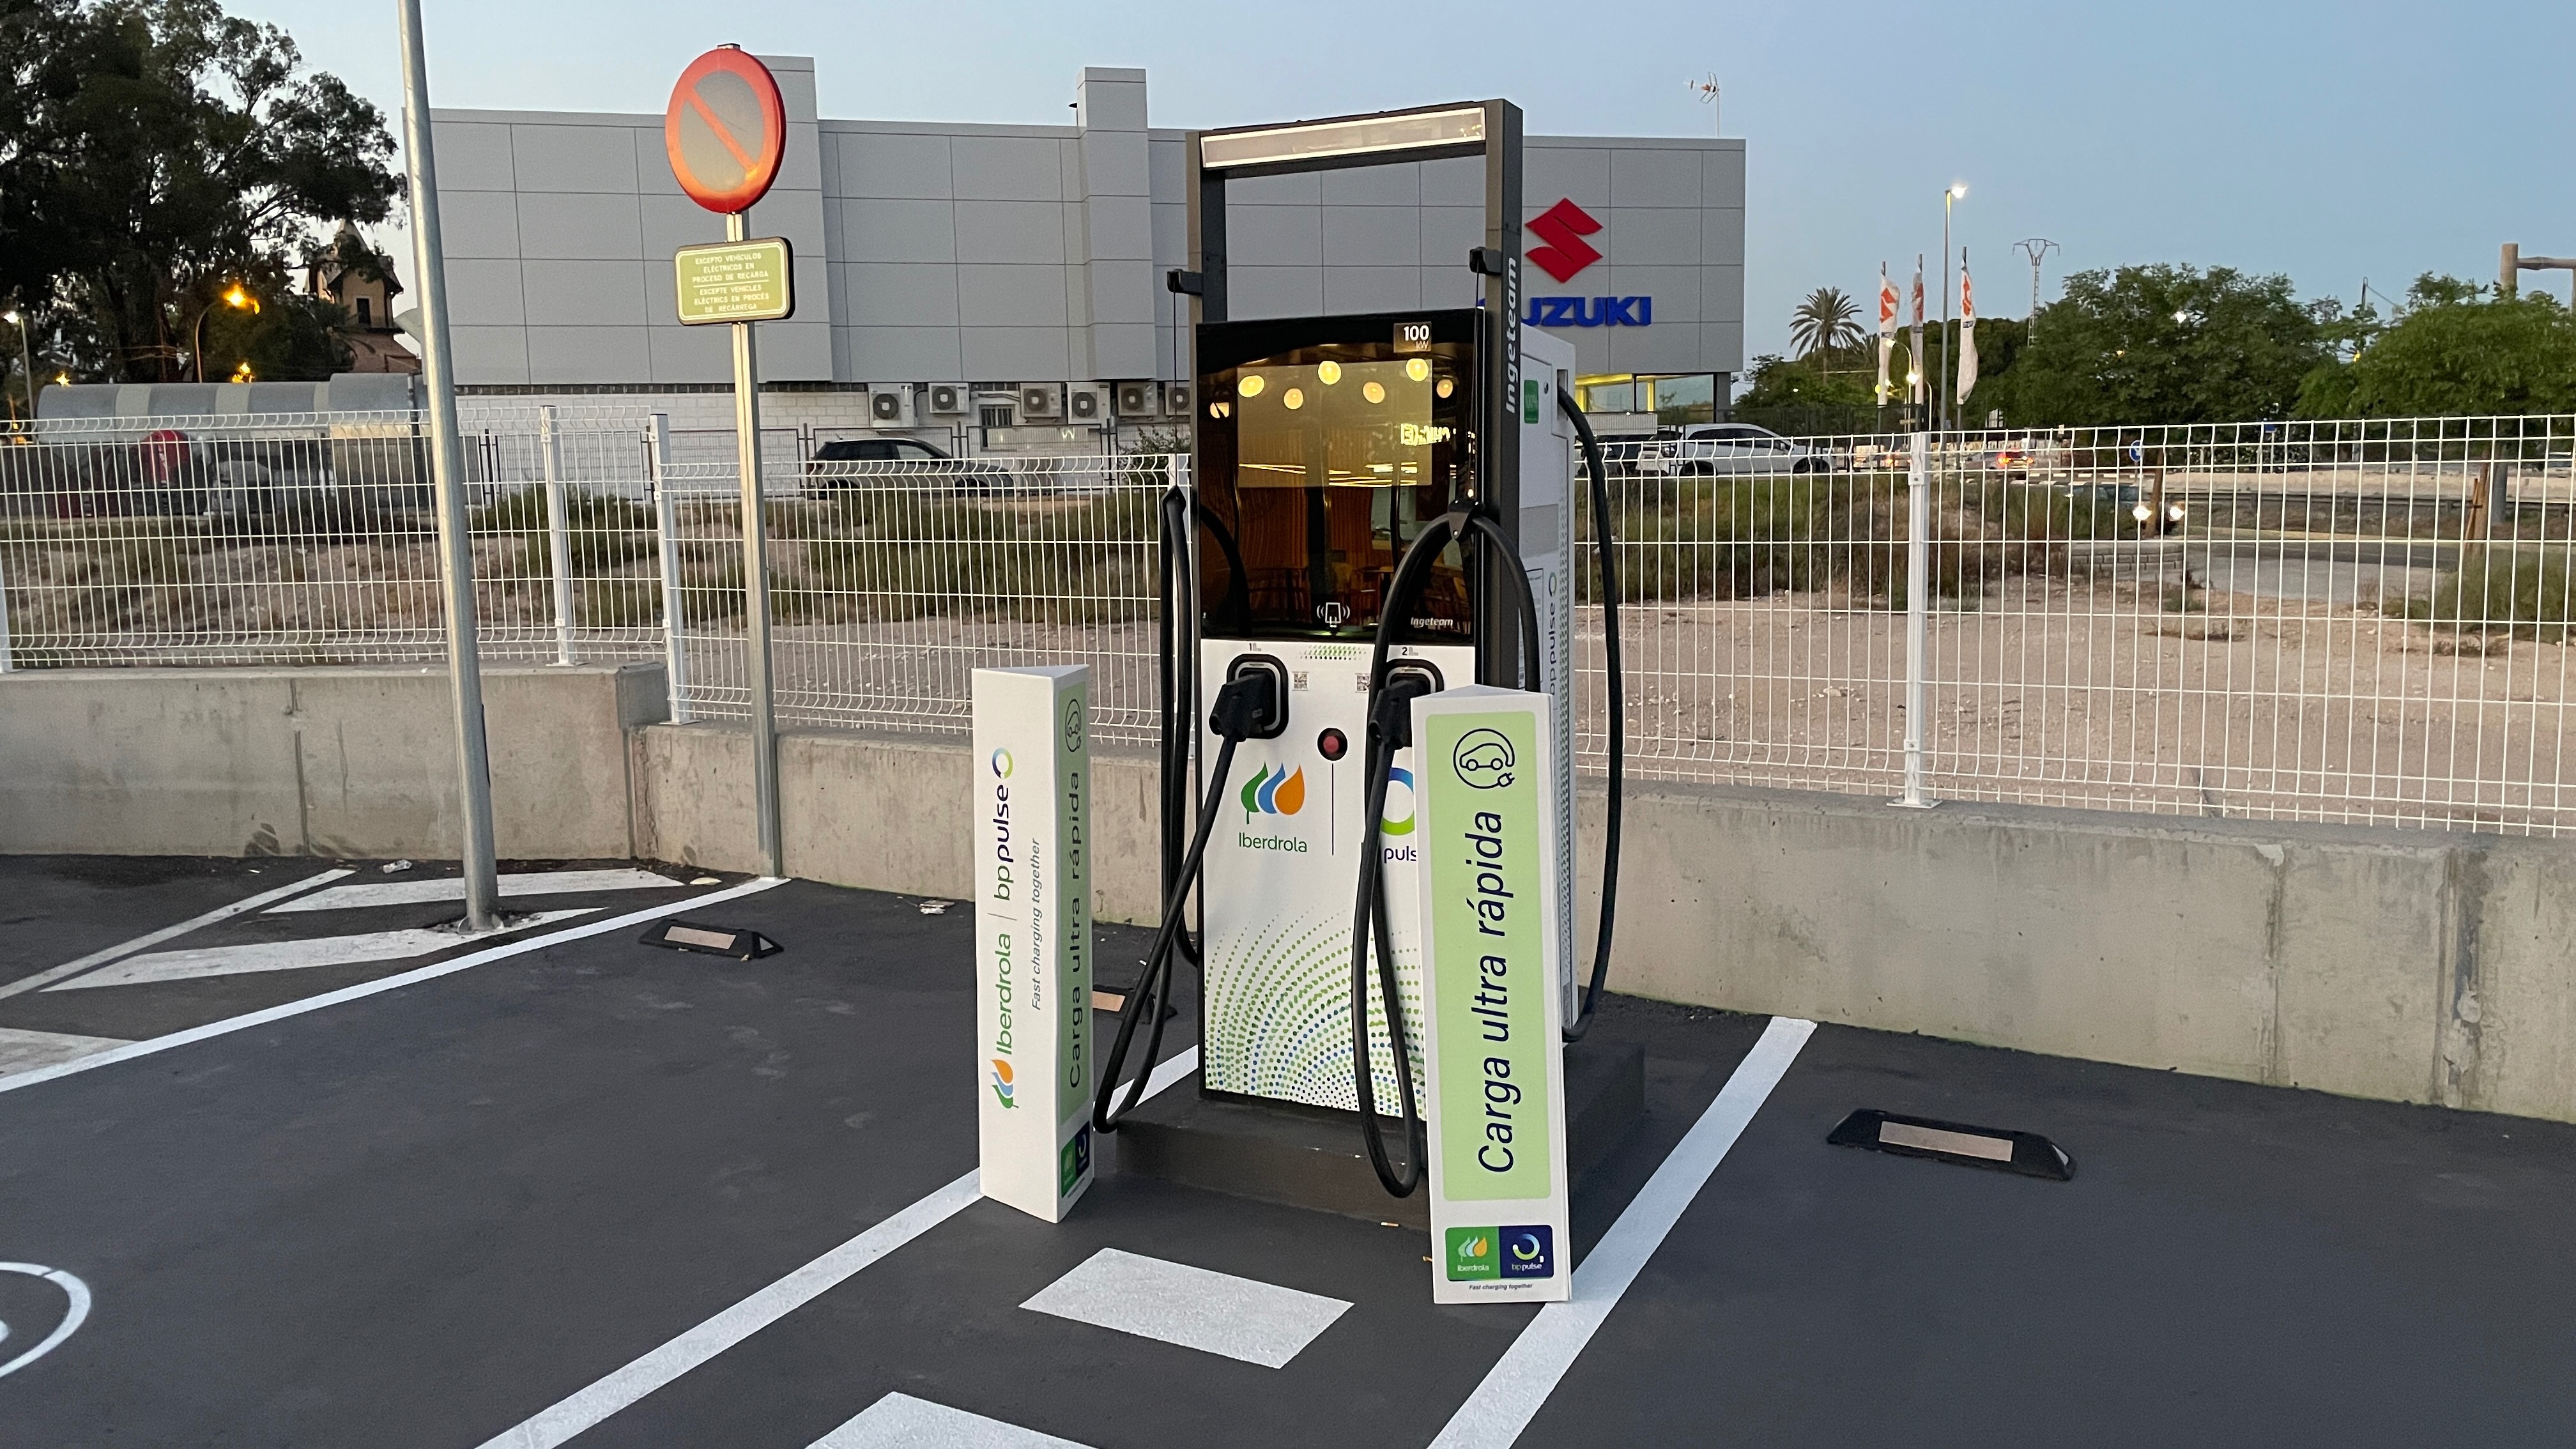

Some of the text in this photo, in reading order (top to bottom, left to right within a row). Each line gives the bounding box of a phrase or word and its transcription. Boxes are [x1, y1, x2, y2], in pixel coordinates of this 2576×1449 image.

[695, 252, 762, 264] EXCEPTO VEHÍCULOS
[737, 270, 769, 279] RECARGA
[700, 284, 762, 295] EXCEPTE VEHICLES
[1404, 325, 1429, 341] 100
[1506, 257, 1519, 413] Ingeteam
[1410, 617, 1453, 628] Ingeteam
[1402, 647, 1407, 656] 2
[1238, 832, 1307, 853] Iberdrola
[1383, 845, 1416, 864] puls
[1029, 838, 1043, 1011] Fast charging together
[1068, 771, 1084, 1089] Carga ultra rápida
[994, 933, 1013, 1055] Iberdrola
[1464, 811, 1521, 1173] Carga ultra rápida
